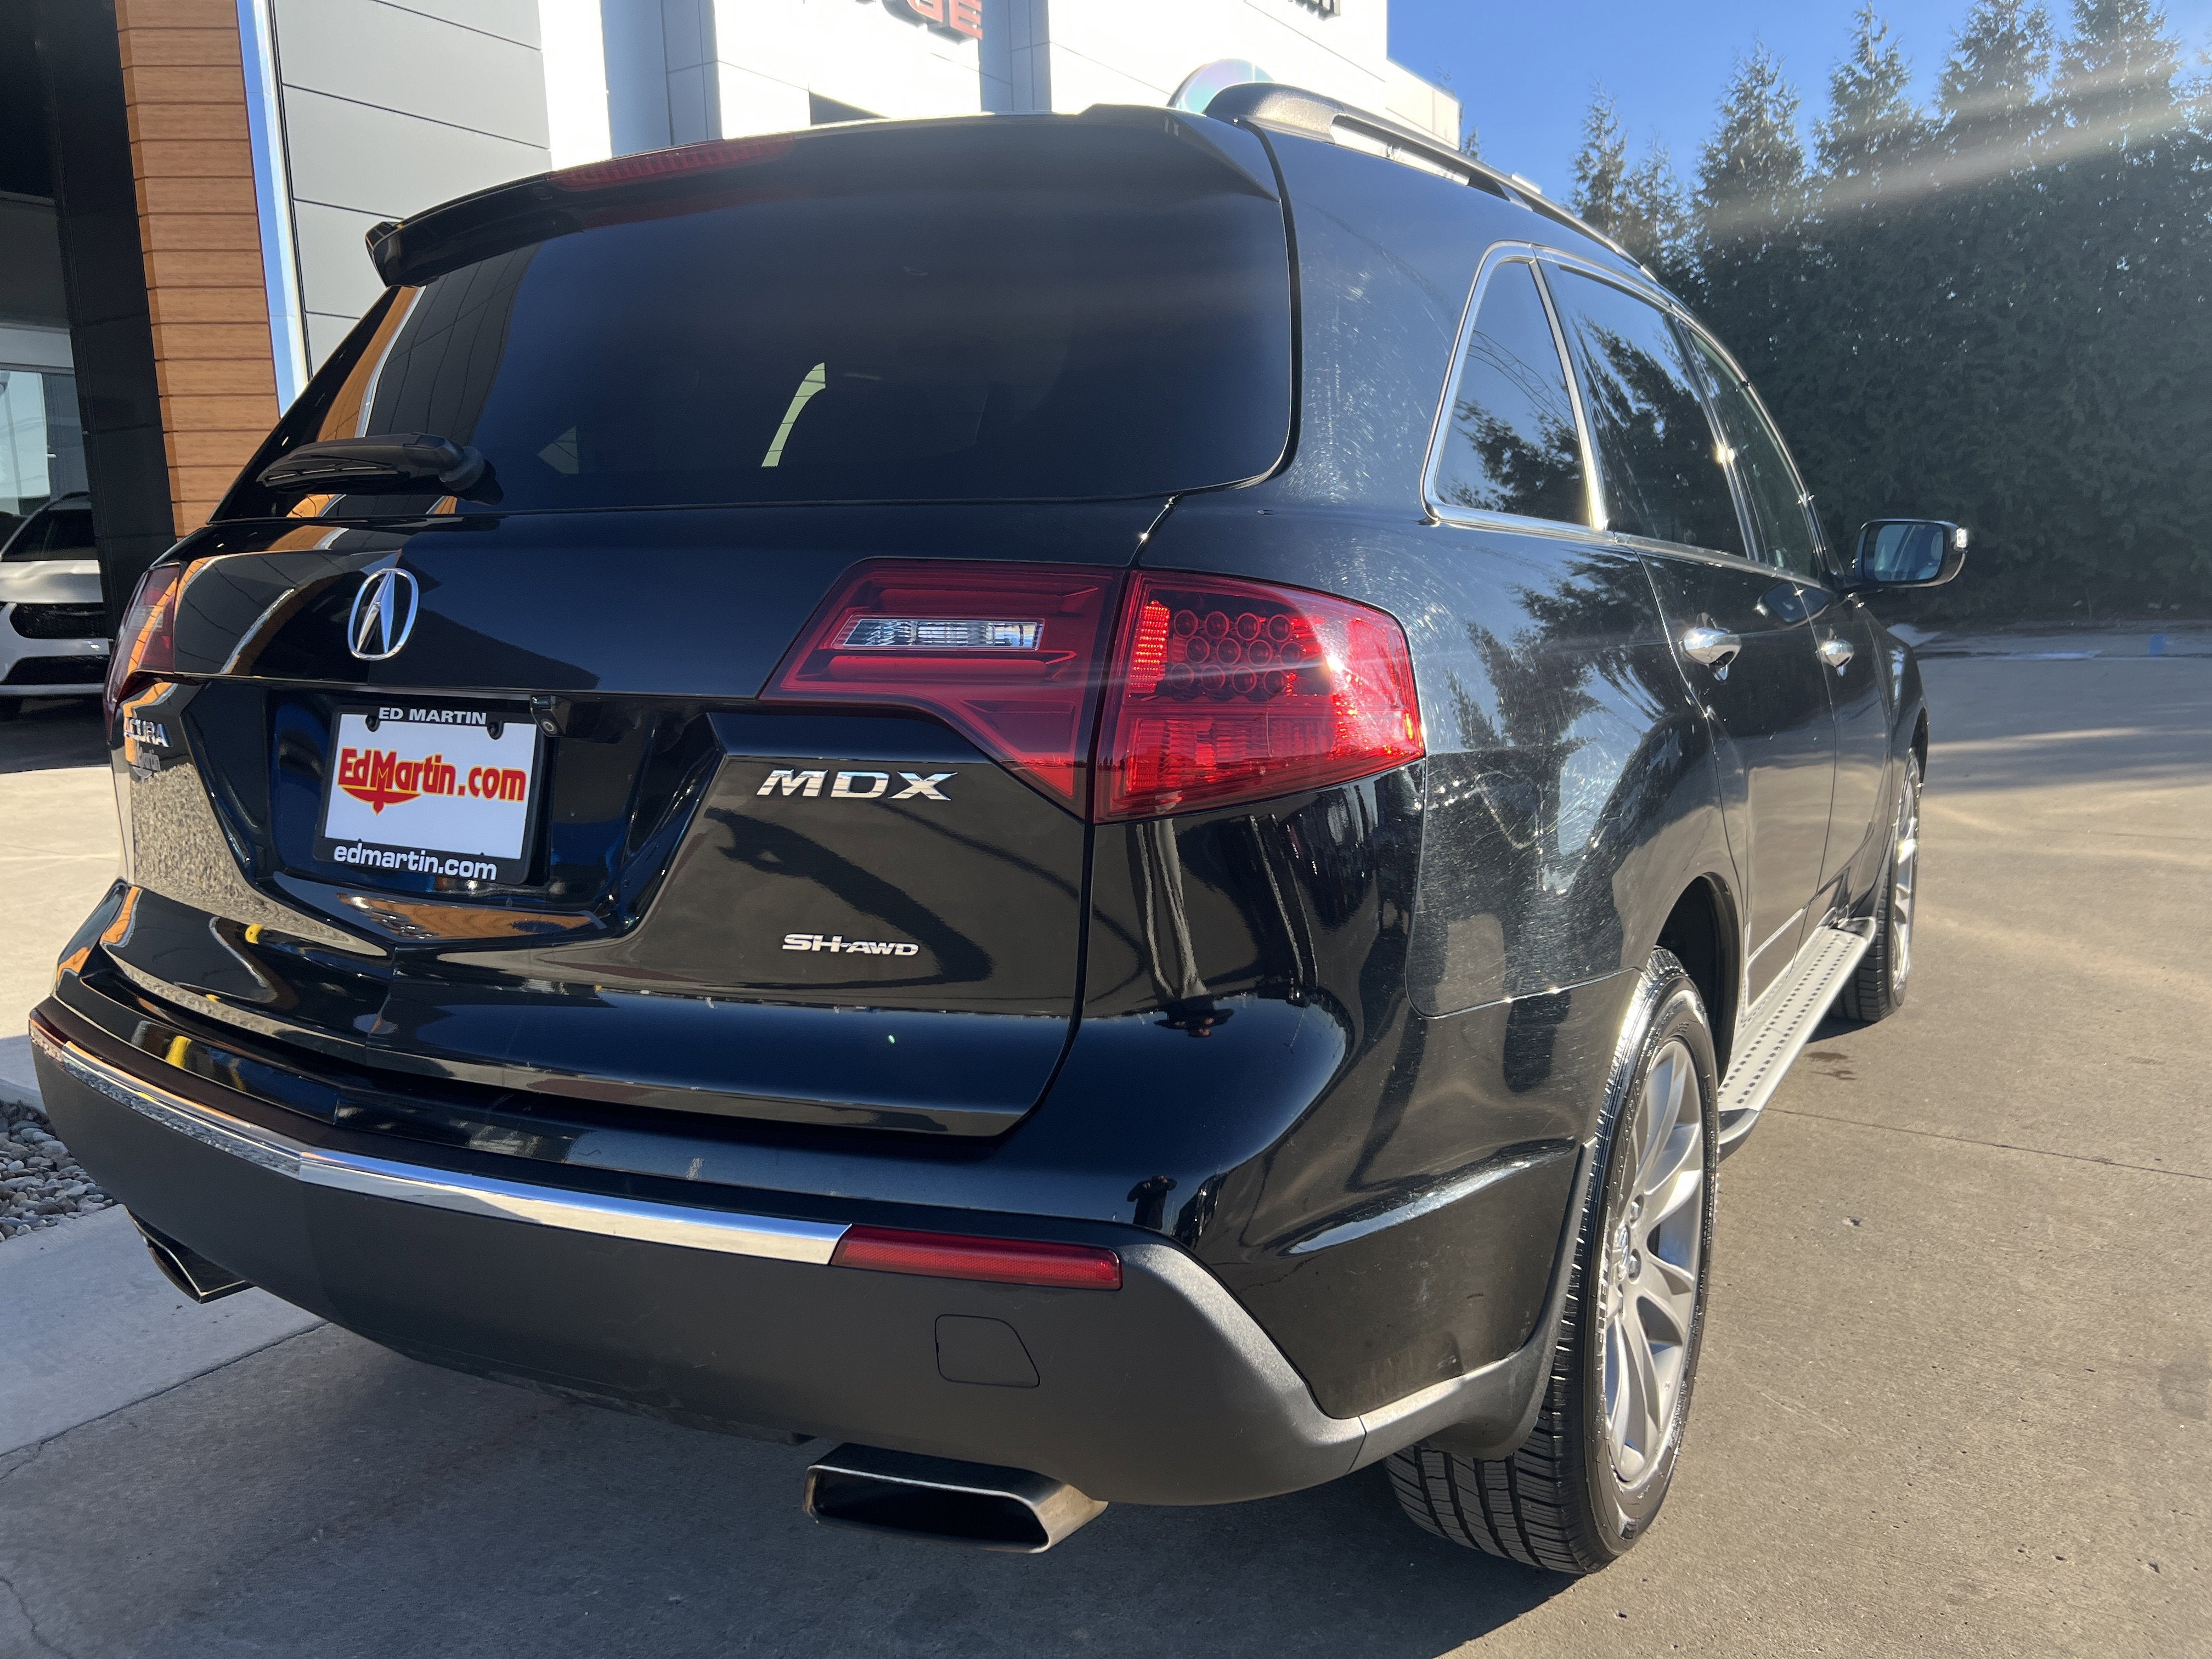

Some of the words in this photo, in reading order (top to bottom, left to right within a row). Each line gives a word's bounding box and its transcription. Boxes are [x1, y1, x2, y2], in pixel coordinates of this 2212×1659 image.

[378, 707, 404, 720] ED
[409, 709, 487, 725] MARTIN
[338, 747, 526, 803] EdMartin.com
[757, 769, 958, 801] MDX
[334, 843, 497, 880] edmartin.com
[782, 934, 919, 956] SH-AWD
